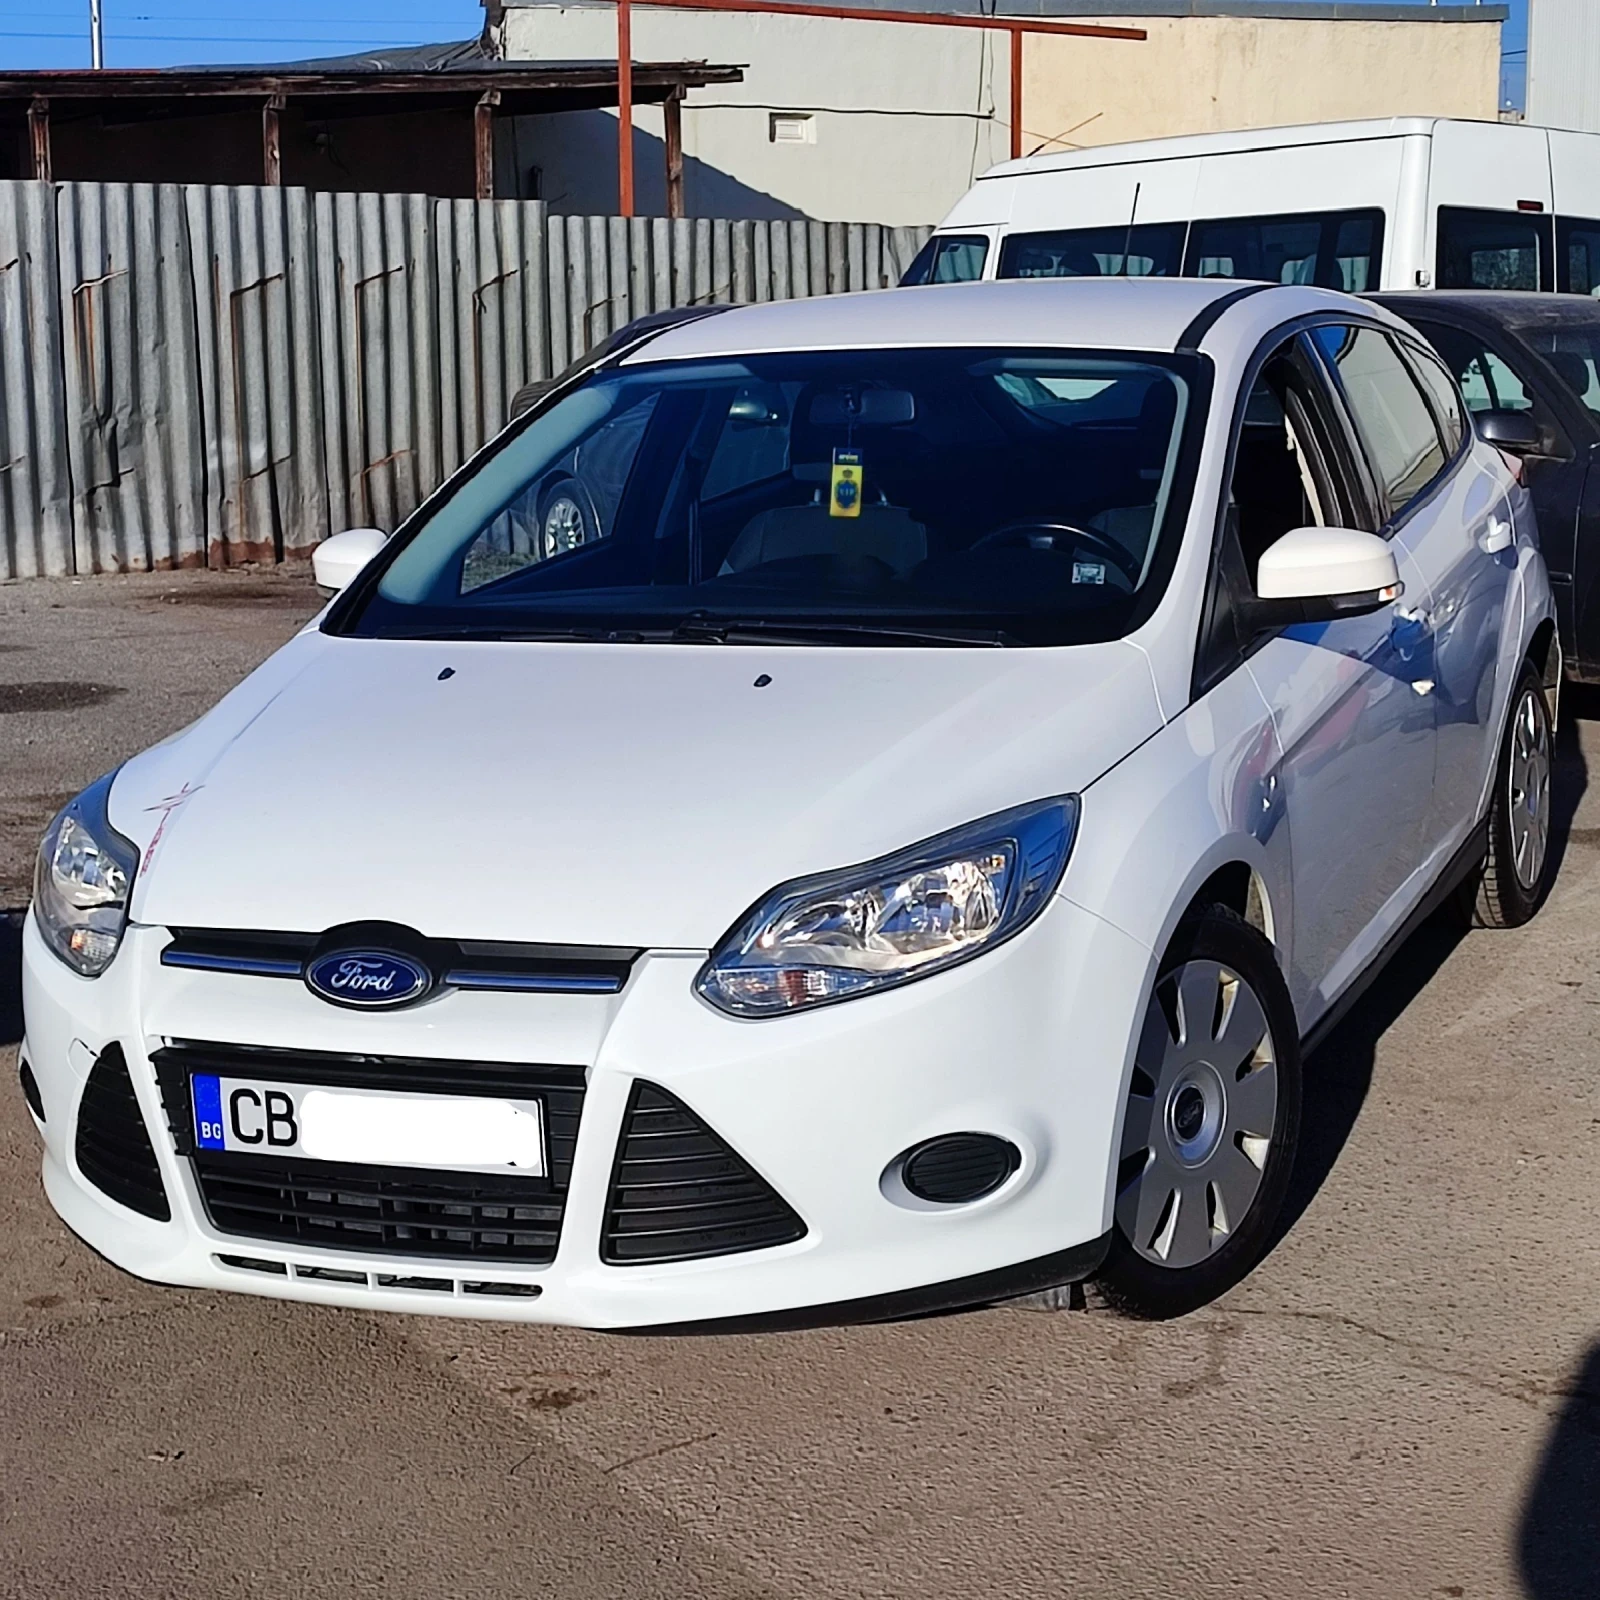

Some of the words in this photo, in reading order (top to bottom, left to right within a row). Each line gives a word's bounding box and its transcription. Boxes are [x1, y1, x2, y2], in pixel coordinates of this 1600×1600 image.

[331, 960, 397, 991] Ford
[201, 1121, 221, 1139] BG
[229, 1088, 298, 1147] CB
